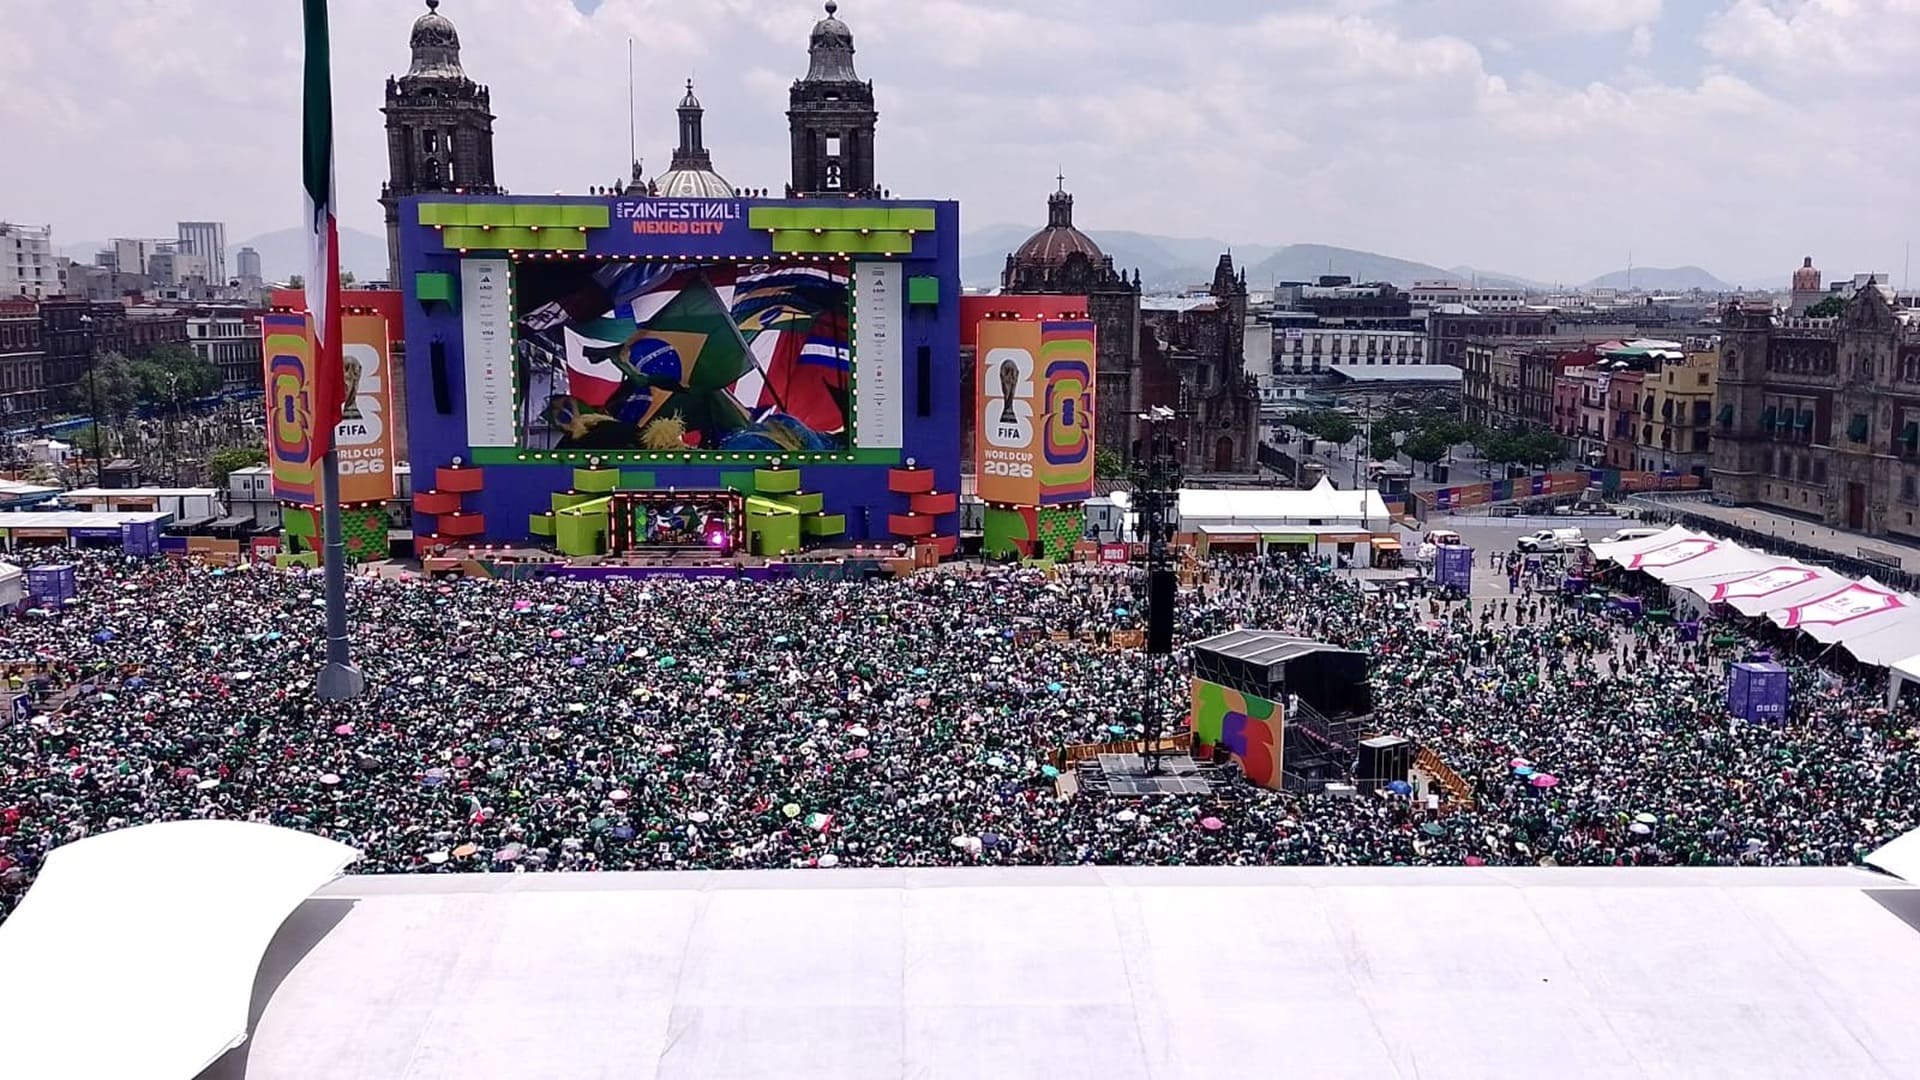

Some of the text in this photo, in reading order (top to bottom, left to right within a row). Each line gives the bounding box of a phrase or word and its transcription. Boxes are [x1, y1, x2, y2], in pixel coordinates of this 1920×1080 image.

[633, 221, 724, 235] MEXICO CITY
[339, 424, 367, 436] FIFA
[998, 427, 1020, 439] FIFA
[363, 448, 384, 458] CUP
[984, 450, 1034, 462] WORLD CUP
[338, 459, 384, 475] 026
[984, 460, 1033, 478] 2026
